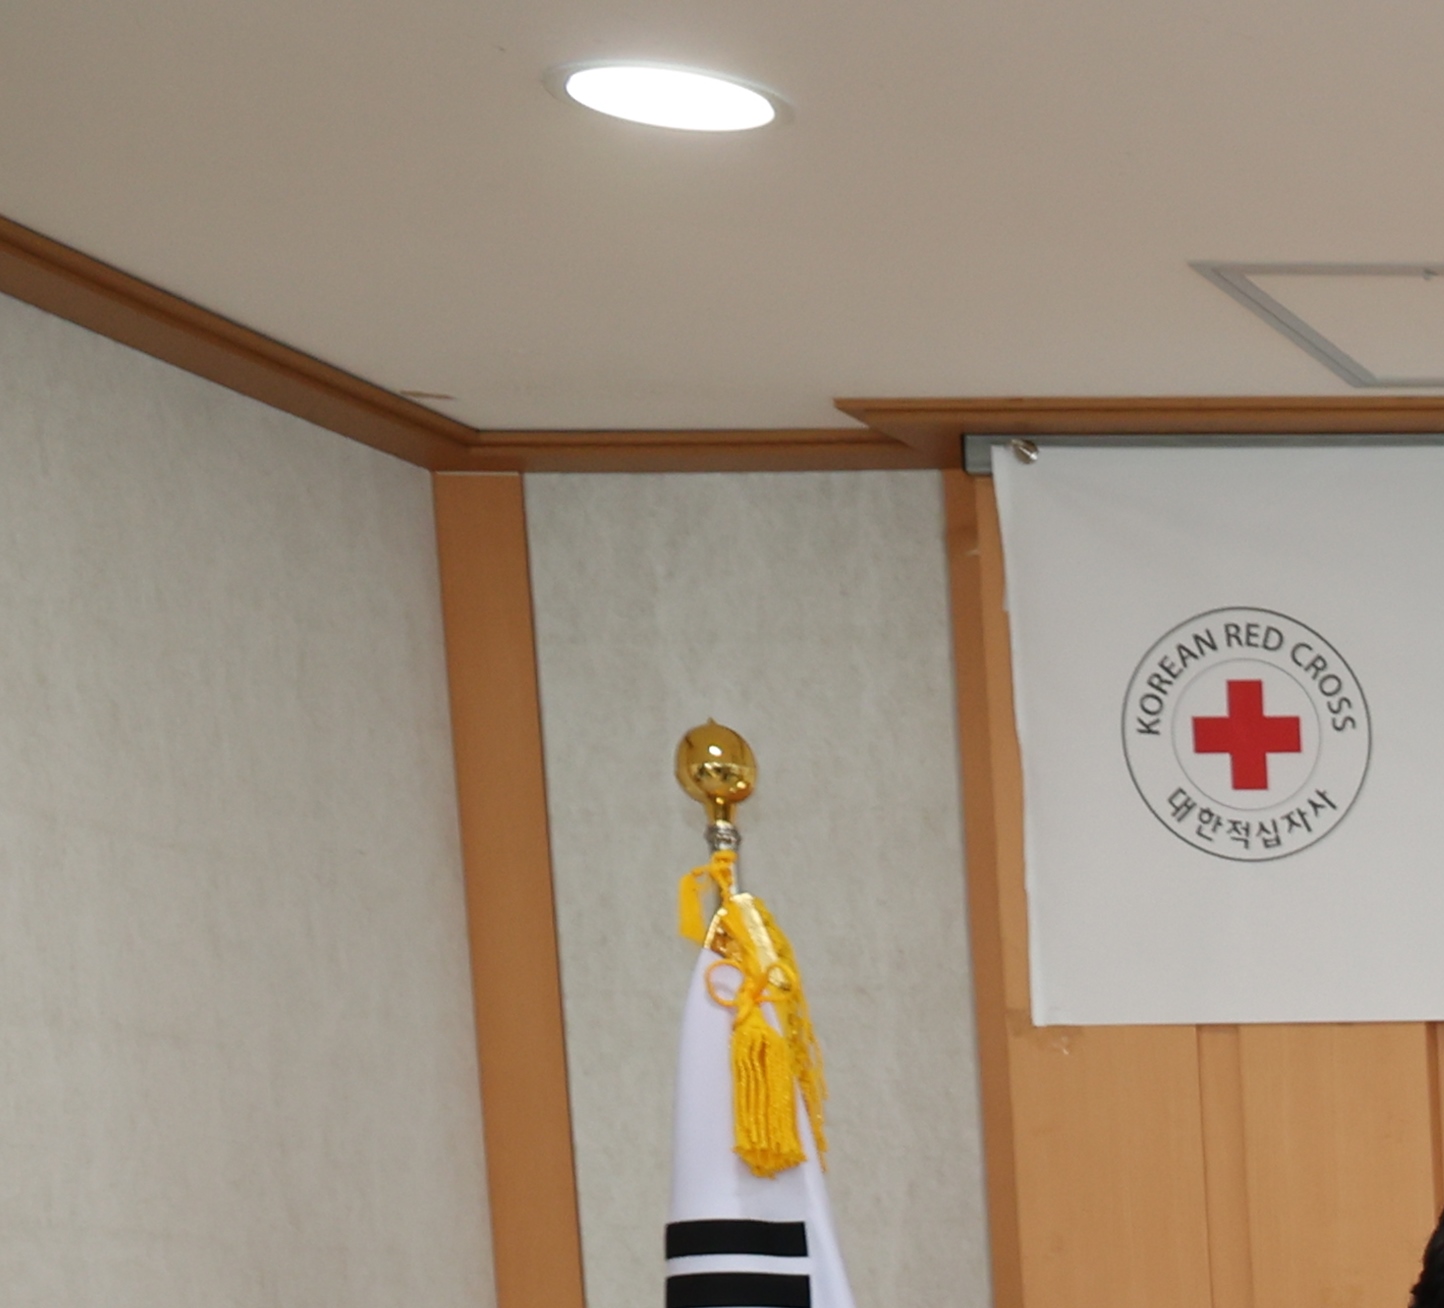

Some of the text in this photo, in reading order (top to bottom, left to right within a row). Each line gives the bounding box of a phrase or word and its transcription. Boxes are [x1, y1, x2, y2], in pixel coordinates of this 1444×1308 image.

[1136, 622, 1356, 736] KOREAN RED CROSS
[1165, 786, 1339, 850] 대한적십자사
